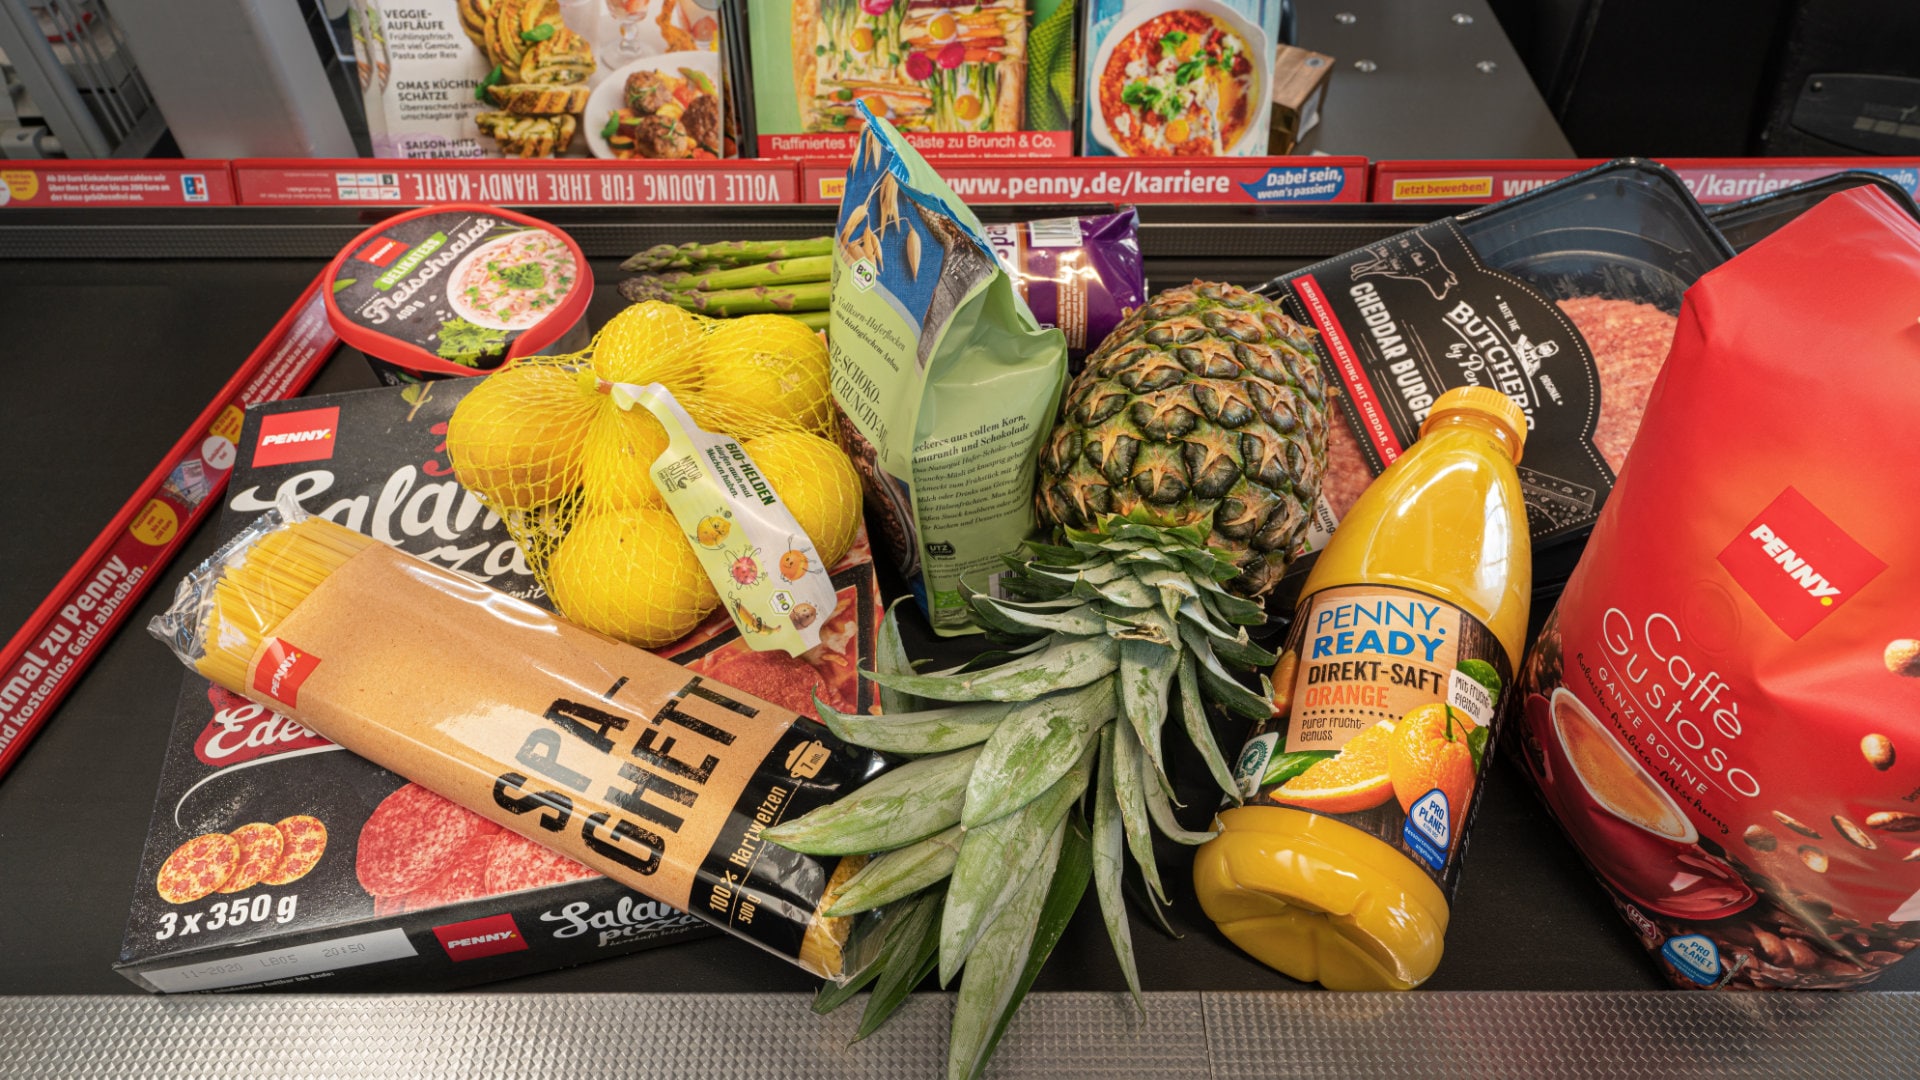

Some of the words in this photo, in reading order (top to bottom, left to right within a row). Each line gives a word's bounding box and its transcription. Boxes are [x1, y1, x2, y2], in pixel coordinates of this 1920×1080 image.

[384, 9, 432, 19] VEGGIE-
[388, 20, 444, 30] AUFLÄUFE
[389, 32, 454, 42] Frühlingsfrisch
[417, 51, 437, 59] oder
[440, 51, 457, 59] Reis
[397, 80, 429, 90] OMAS
[398, 90, 448, 101] SCHÄTZE
[400, 102, 458, 111] Überraschend
[401, 111, 452, 121] unschlagbar
[405, 138, 476, 150] SAISON-HITS
[407, 150, 427, 159] MIT
[772, 135, 847, 151] Raffiniertes
[908, 134, 940, 149] Gäste
[943, 137, 959, 149] zu
[962, 134, 1015, 149] Brunch
[1018, 135, 1029, 148] &
[1031, 134, 1056, 148] Co.
[404, 172, 539, 201] HANDY-KARTE.
[548, 173, 593, 201] IHRE
[601, 173, 635, 204] FÜR
[643, 173, 715, 201] LADUNG
[724, 173, 780, 201] VOLLE
[1257, 187, 1293, 200] wenn's
[1295, 182, 1336, 198] passiert!
[1266, 169, 1307, 187] Dabei
[1308, 167, 1343, 184] sein,
[1400, 184, 1426, 195] Jetzt
[1428, 181, 1487, 195] bewerben!
[361, 217, 496, 324] Fleischsalat
[381, 238, 441, 285] DELIKATESS
[856, 264, 873, 282] BIO
[396, 305, 416, 320] 400
[1498, 301, 1513, 322] TASTE
[1507, 318, 1520, 332] THE
[1300, 281, 1360, 382] RINDFLEISCHZUBEREITUNG
[1354, 382, 1368, 400] MIT
[1363, 400, 1386, 448] CHEDDAR,
[1350, 281, 1402, 361] CHEDDAR
[1389, 357, 1432, 426] BURGE
[1446, 342, 1468, 359] by
[253, 372, 268, 387] Euro
[1538, 373, 1562, 403] ORIGINAL
[261, 427, 331, 447] PENNY.
[912, 437, 949, 454] eckeres
[950, 431, 969, 443] aus
[969, 423, 1000, 438] vollem
[1001, 414, 1027, 428] Korn.
[912, 446, 959, 465] Amaranth
[961, 441, 979, 453] und
[980, 423, 1030, 445] Schokolade
[668, 460, 686, 481] GUT
[680, 455, 703, 483] NATUR
[705, 447, 726, 475] Machen
[714, 445, 732, 467] dürfen
[728, 465, 743, 485] auch
[739, 483, 753, 498] mal
[725, 443, 776, 506] BIO-HELDEN
[133, 502, 158, 530] Auszahlung
[146, 515, 156, 526] von
[929, 544, 949, 552] UTZ
[1749, 523, 1842, 607] PENNY.
[39, 622, 73, 658] zu
[60, 554, 130, 627] Penny
[1316, 600, 1446, 634] PENNY.
[9, 654, 74, 728] kostenlos
[67, 620, 101, 656] Geld
[94, 564, 149, 626] abheben.
[1311, 629, 1445, 663] READY
[271, 650, 302, 697] PENNY.
[1307, 660, 1443, 695] DIREKT-SAFT
[1455, 676, 1469, 693] Mit
[1645, 612, 1743, 740] Caffè
[1304, 684, 1390, 709] ORANGE
[1576, 652, 1731, 835] Robusta-Arabica-Mischung
[1597, 666, 1643, 729] GANZE
[1646, 732, 1709, 795] BOHNE
[492, 676, 630, 833] SPA-
[801, 761, 814, 772] 7
[1419, 806, 1447, 837] PLANET
[1429, 800, 1445, 820] PRO
[729, 785, 788, 868] Hartweizen
[720, 870, 738, 889] %
[709, 884, 732, 913] 100
[738, 903, 757, 925] 500
[749, 893, 763, 907] g
[155, 912, 176, 941] 3
[179, 913, 202, 936] x
[206, 894, 271, 932] 350
[278, 894, 298, 924] g
[1631, 909, 1652, 931] UTZ
[447, 930, 517, 950] PENNY.
[1690, 941, 1711, 957] PRO
[181, 962, 244, 981] 11-2020
[321, 942, 366, 958] 20:50
[1677, 943, 1713, 968] PLANET
[264, 976, 295, 989] haltbar
[296, 974, 309, 982] bis
[310, 970, 335, 981] Ende:
